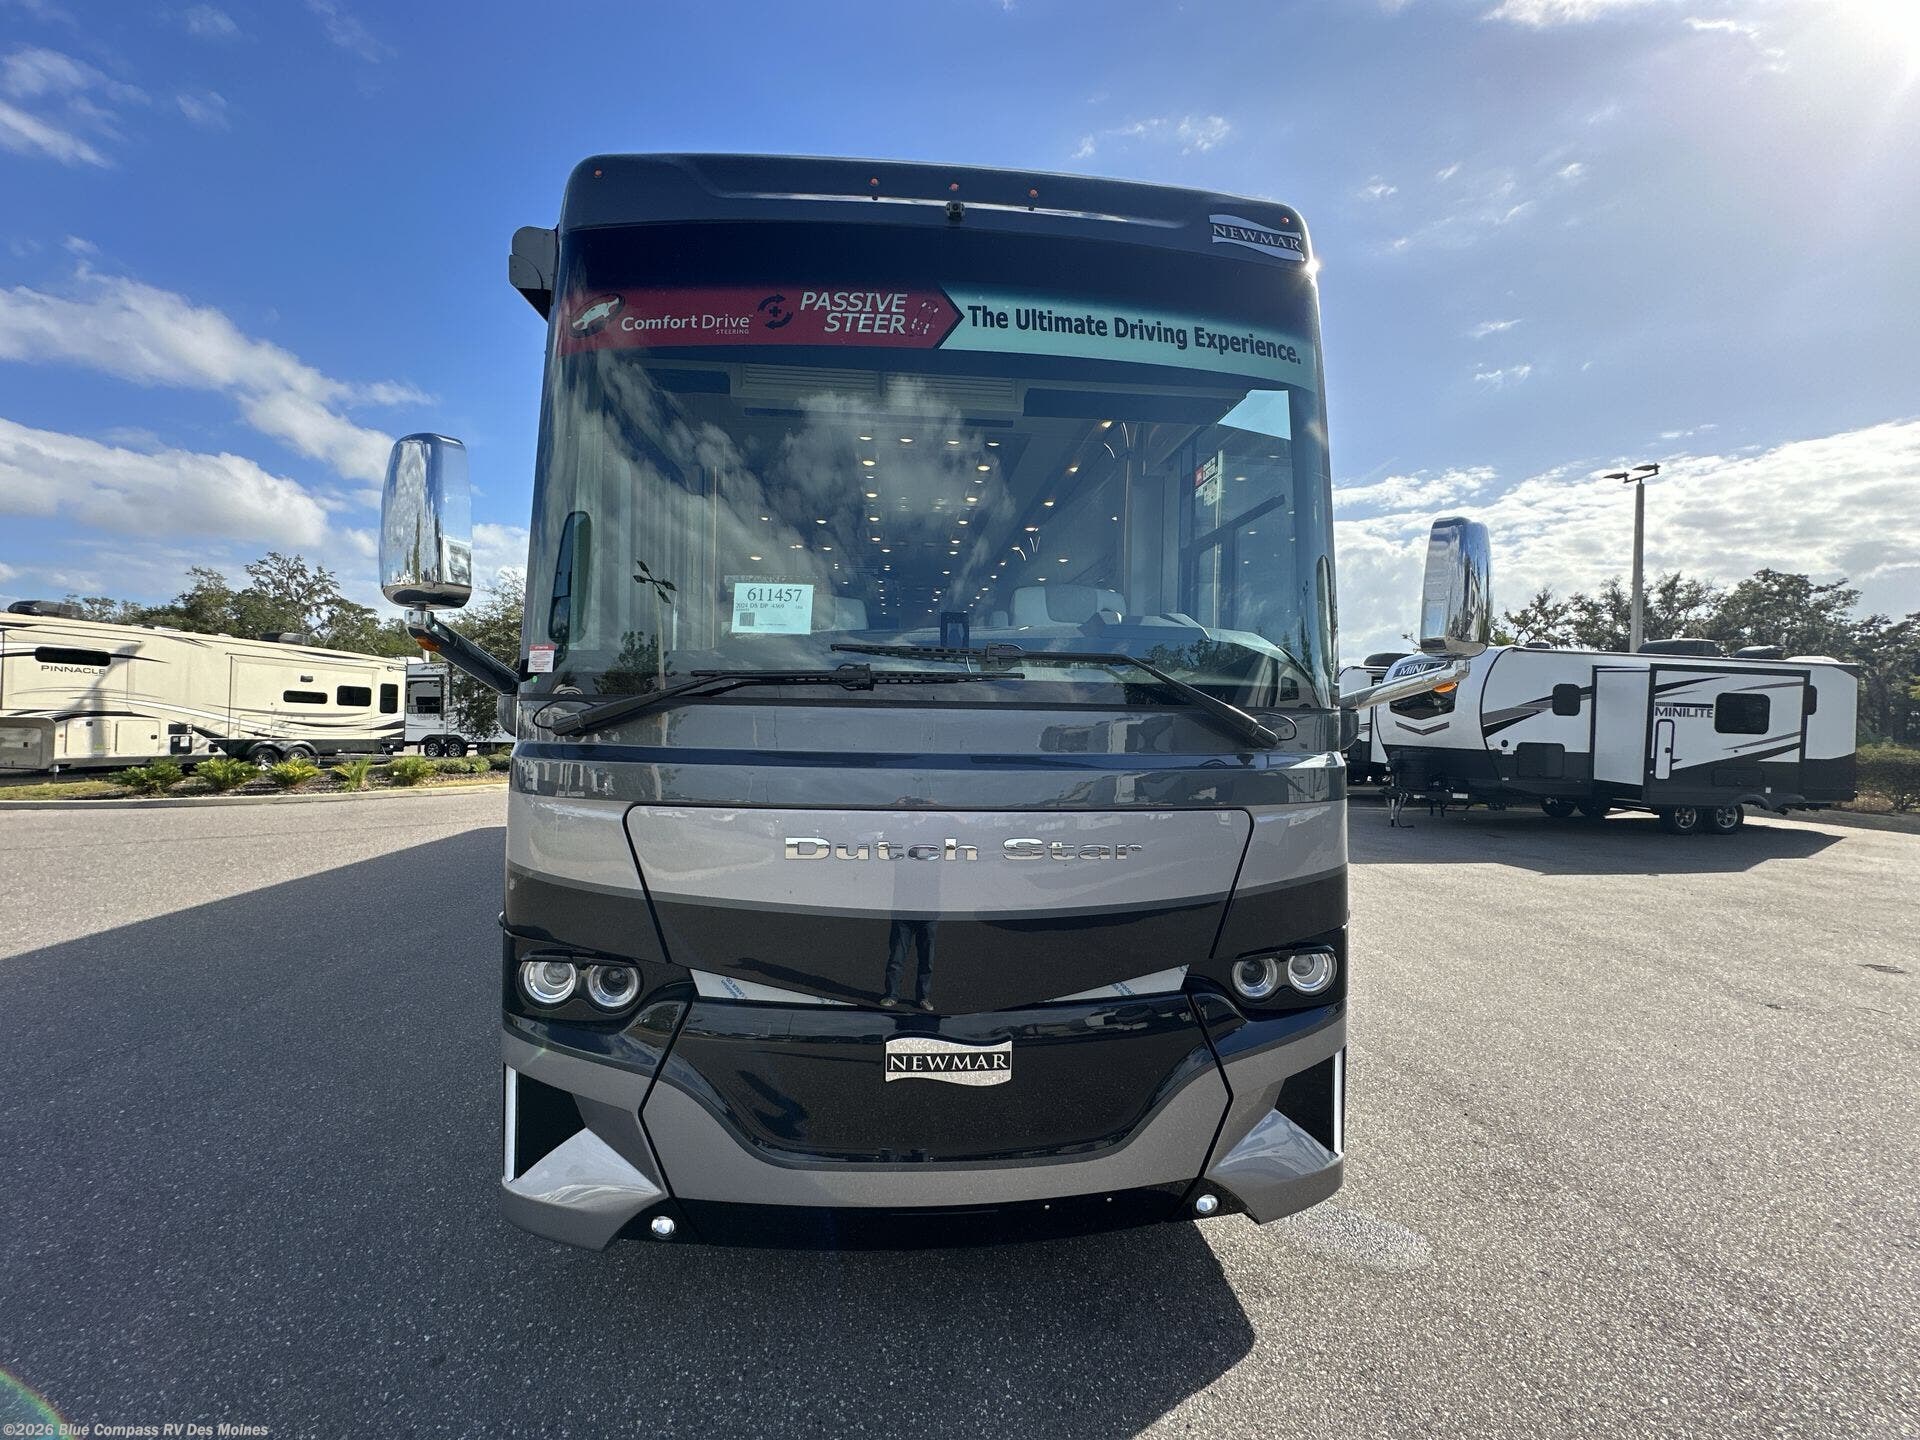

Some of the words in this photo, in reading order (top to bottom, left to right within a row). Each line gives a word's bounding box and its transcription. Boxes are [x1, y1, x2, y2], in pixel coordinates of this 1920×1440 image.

[1213, 223, 1302, 252] NEWMAR
[800, 291, 907, 313] PASSIVE
[621, 315, 698, 331] Comfort
[824, 312, 906, 334] STEER
[967, 305, 1009, 329] The
[1015, 308, 1108, 337] Ultimate
[1114, 317, 1188, 350] Driving
[1194, 326, 1302, 364] Experience.
[747, 587, 802, 602] 611457
[41, 665, 105, 675] PINNACLE
[1654, 707, 1714, 718] MINILITE
[785, 837, 979, 861] Dutch
[1002, 837, 1143, 861] Star
[889, 1053, 1009, 1072] NEWMAR
